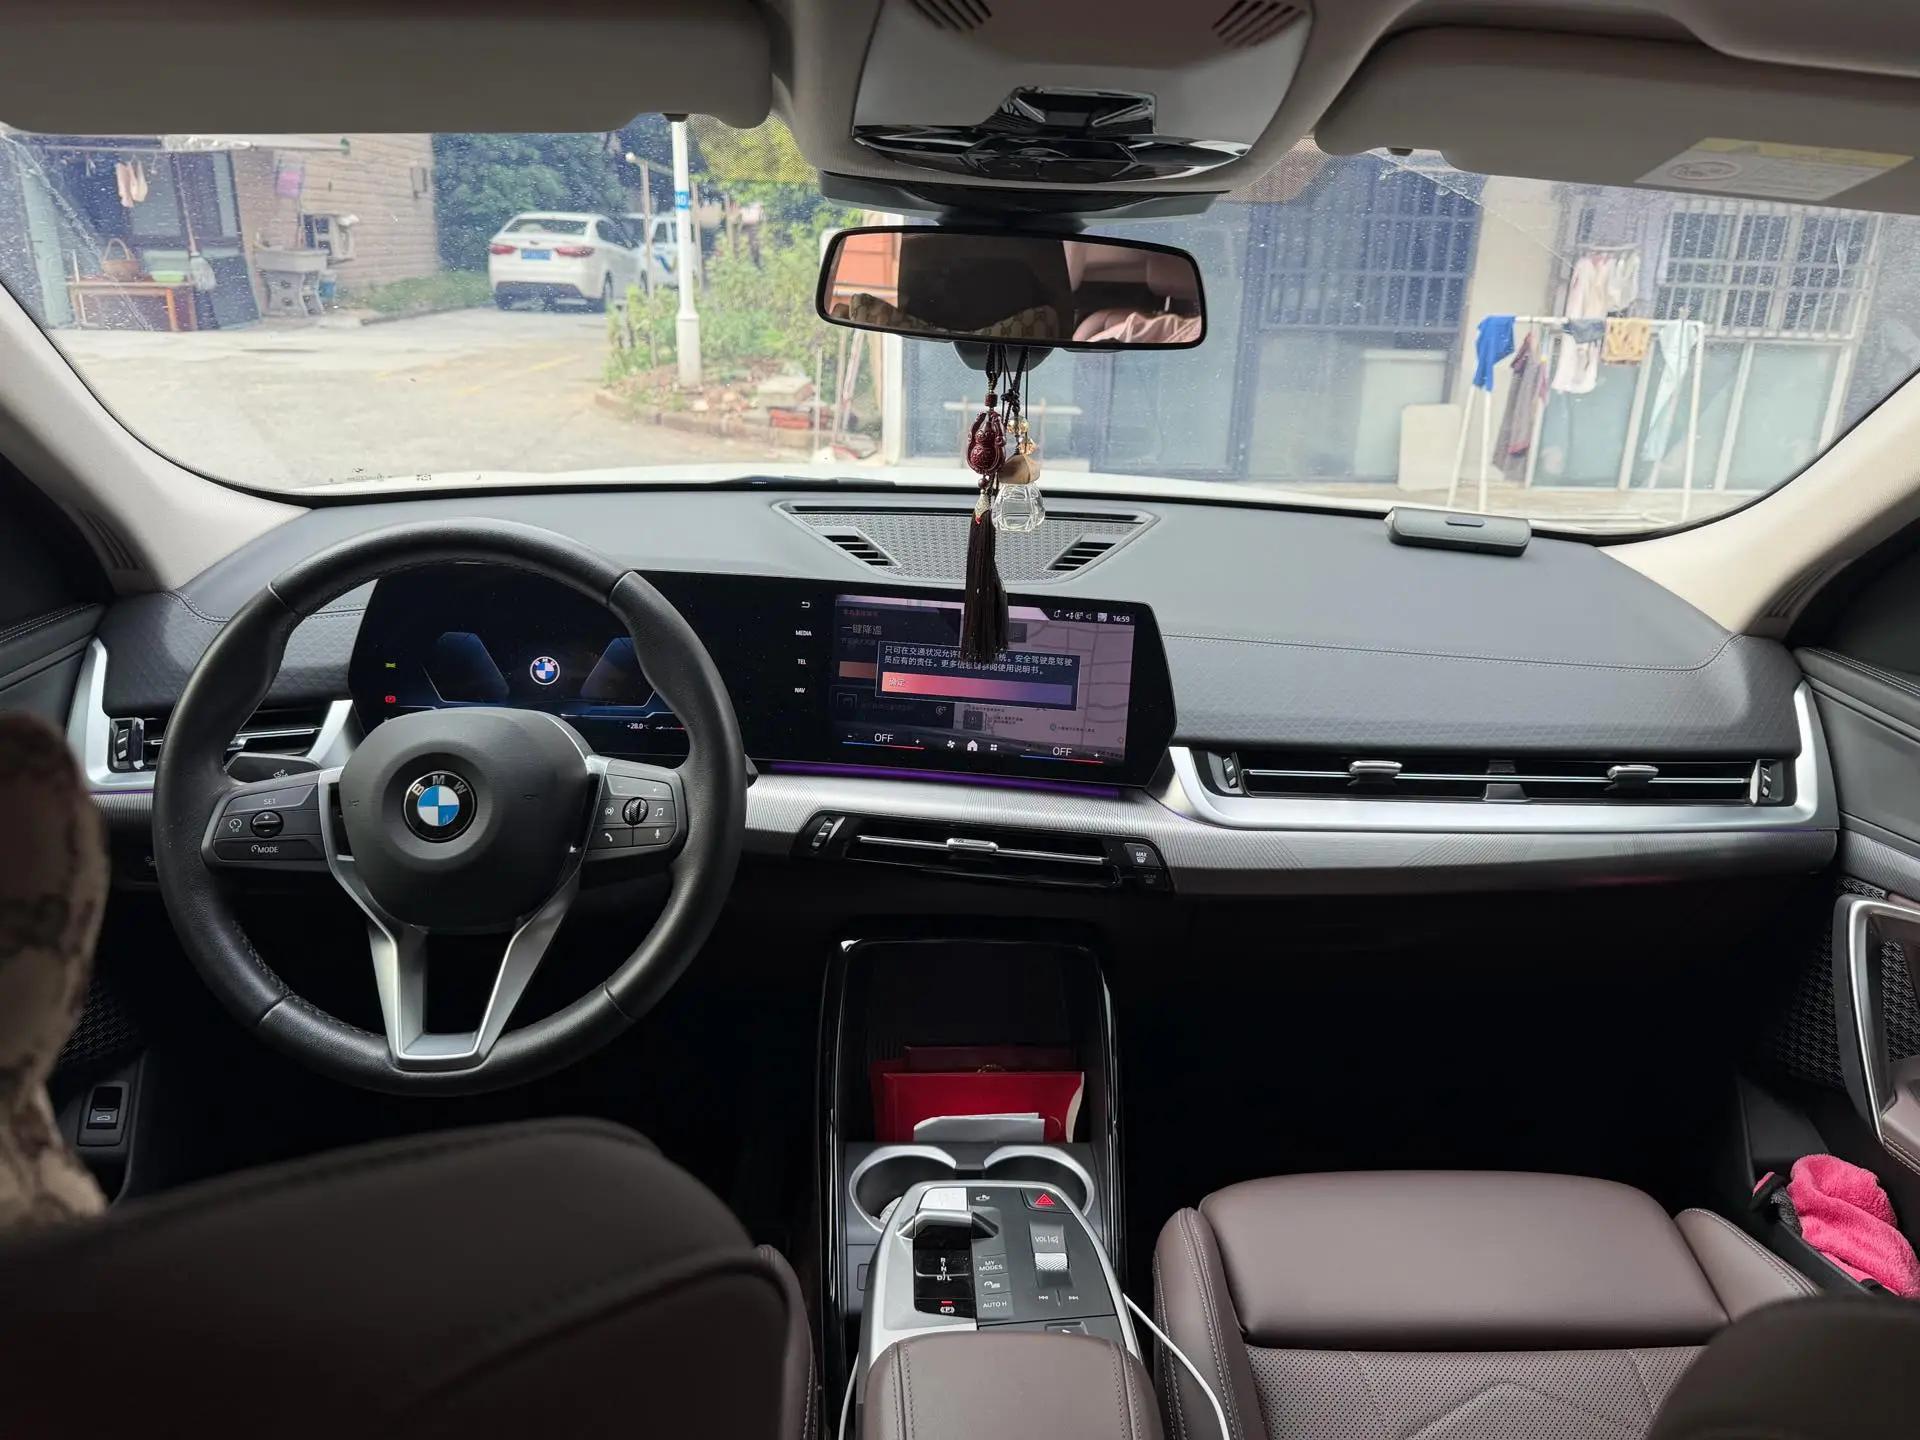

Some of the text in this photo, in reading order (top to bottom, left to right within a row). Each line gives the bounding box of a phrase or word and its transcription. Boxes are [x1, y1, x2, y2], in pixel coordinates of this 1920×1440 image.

[1112, 615, 1130, 623] 16:59
[874, 733, 894, 743] OFF
[1052, 746, 1073, 757] OFF
[411, 774, 468, 796] BMW
[258, 845, 279, 853] MODE
[983, 1301, 1001, 1309] AUTO
